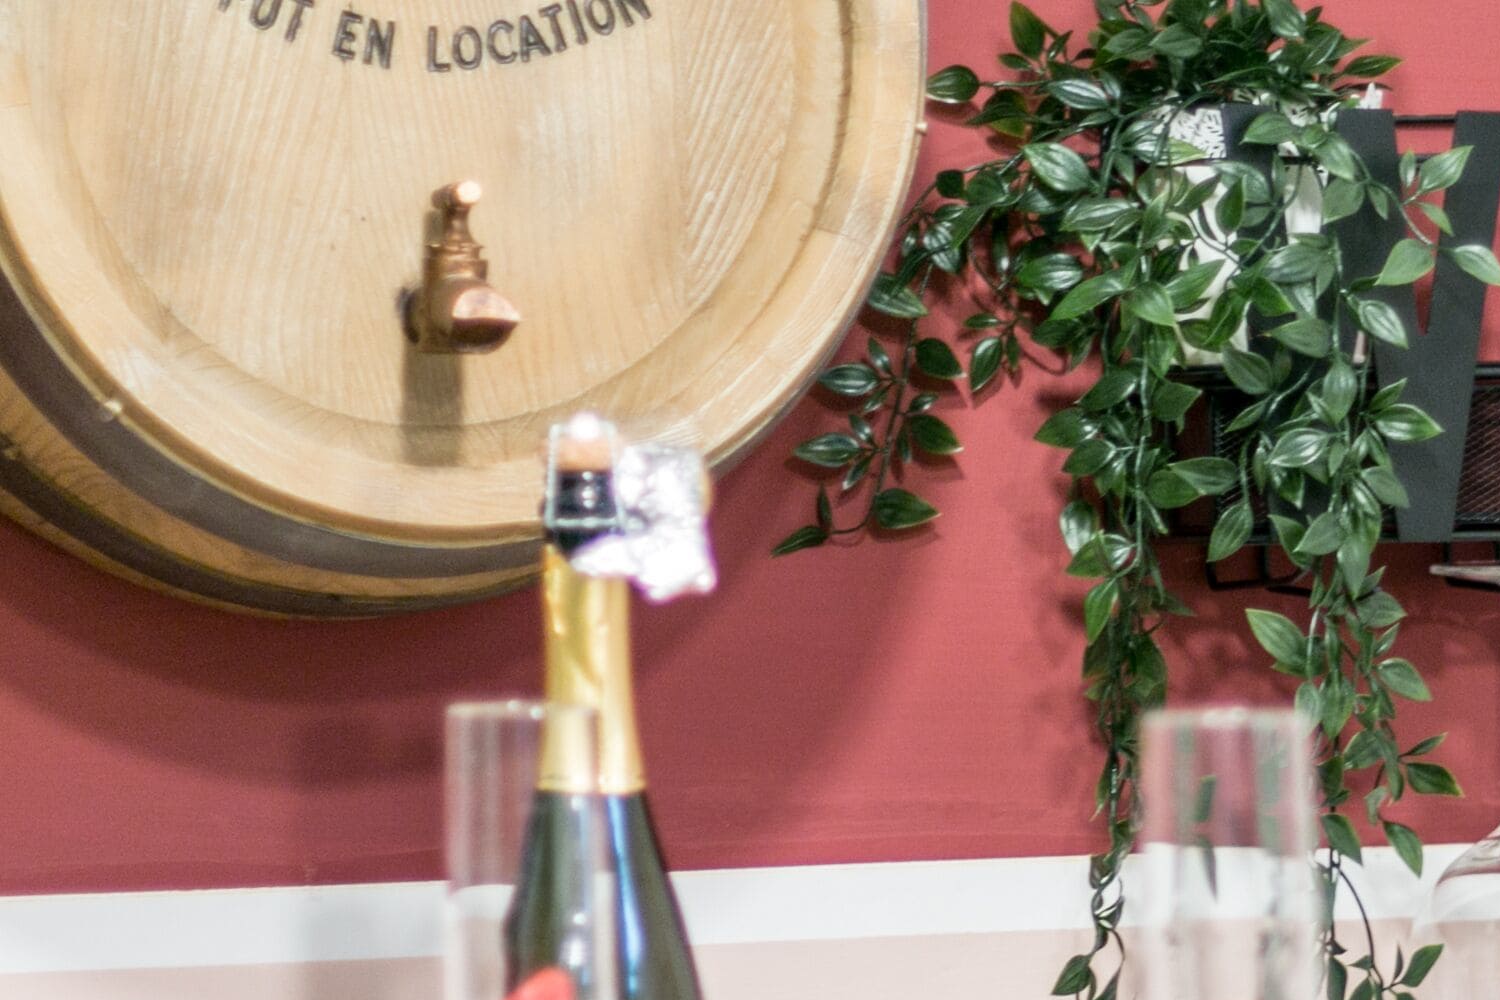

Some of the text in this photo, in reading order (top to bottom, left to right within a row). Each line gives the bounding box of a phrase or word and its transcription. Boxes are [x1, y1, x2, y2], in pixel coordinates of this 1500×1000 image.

[217, 0, 653, 73] UT EN LOCATION
